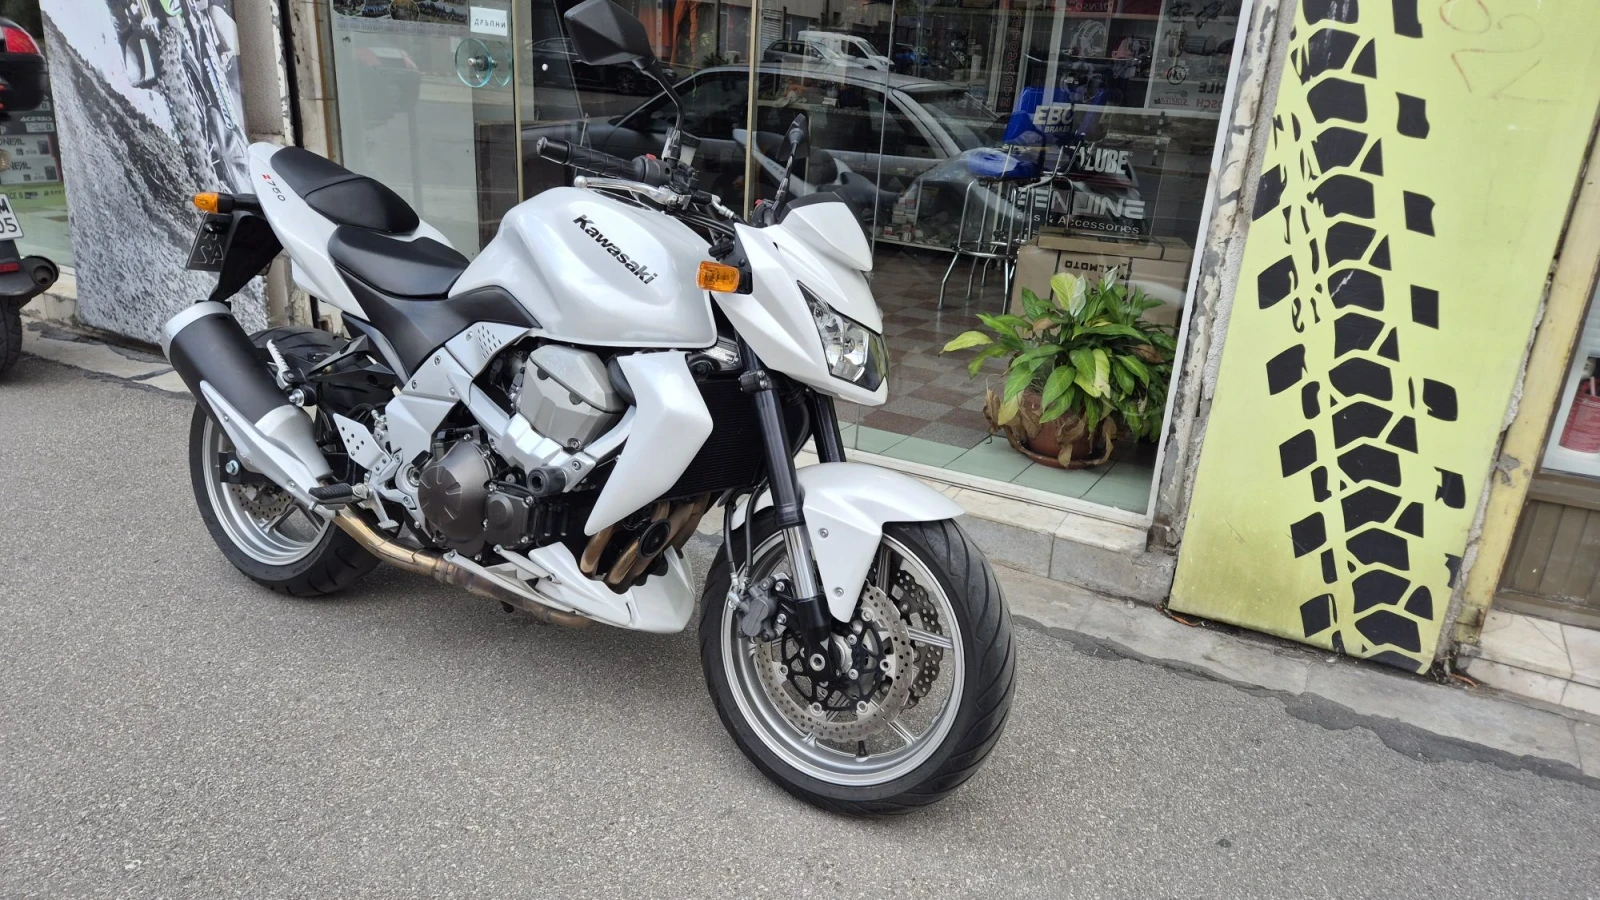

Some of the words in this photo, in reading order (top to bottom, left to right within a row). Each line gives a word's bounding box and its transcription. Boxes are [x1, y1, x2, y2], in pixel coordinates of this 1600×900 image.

[474, 18, 506, 28] ДРЪПНИ
[1033, 104, 1073, 125] EBC
[1044, 125, 1072, 133] BRAKES
[8, 161, 32, 171] NEAL
[1058, 215, 1140, 234] Accessories
[573, 214, 658, 285] Kawasaki
